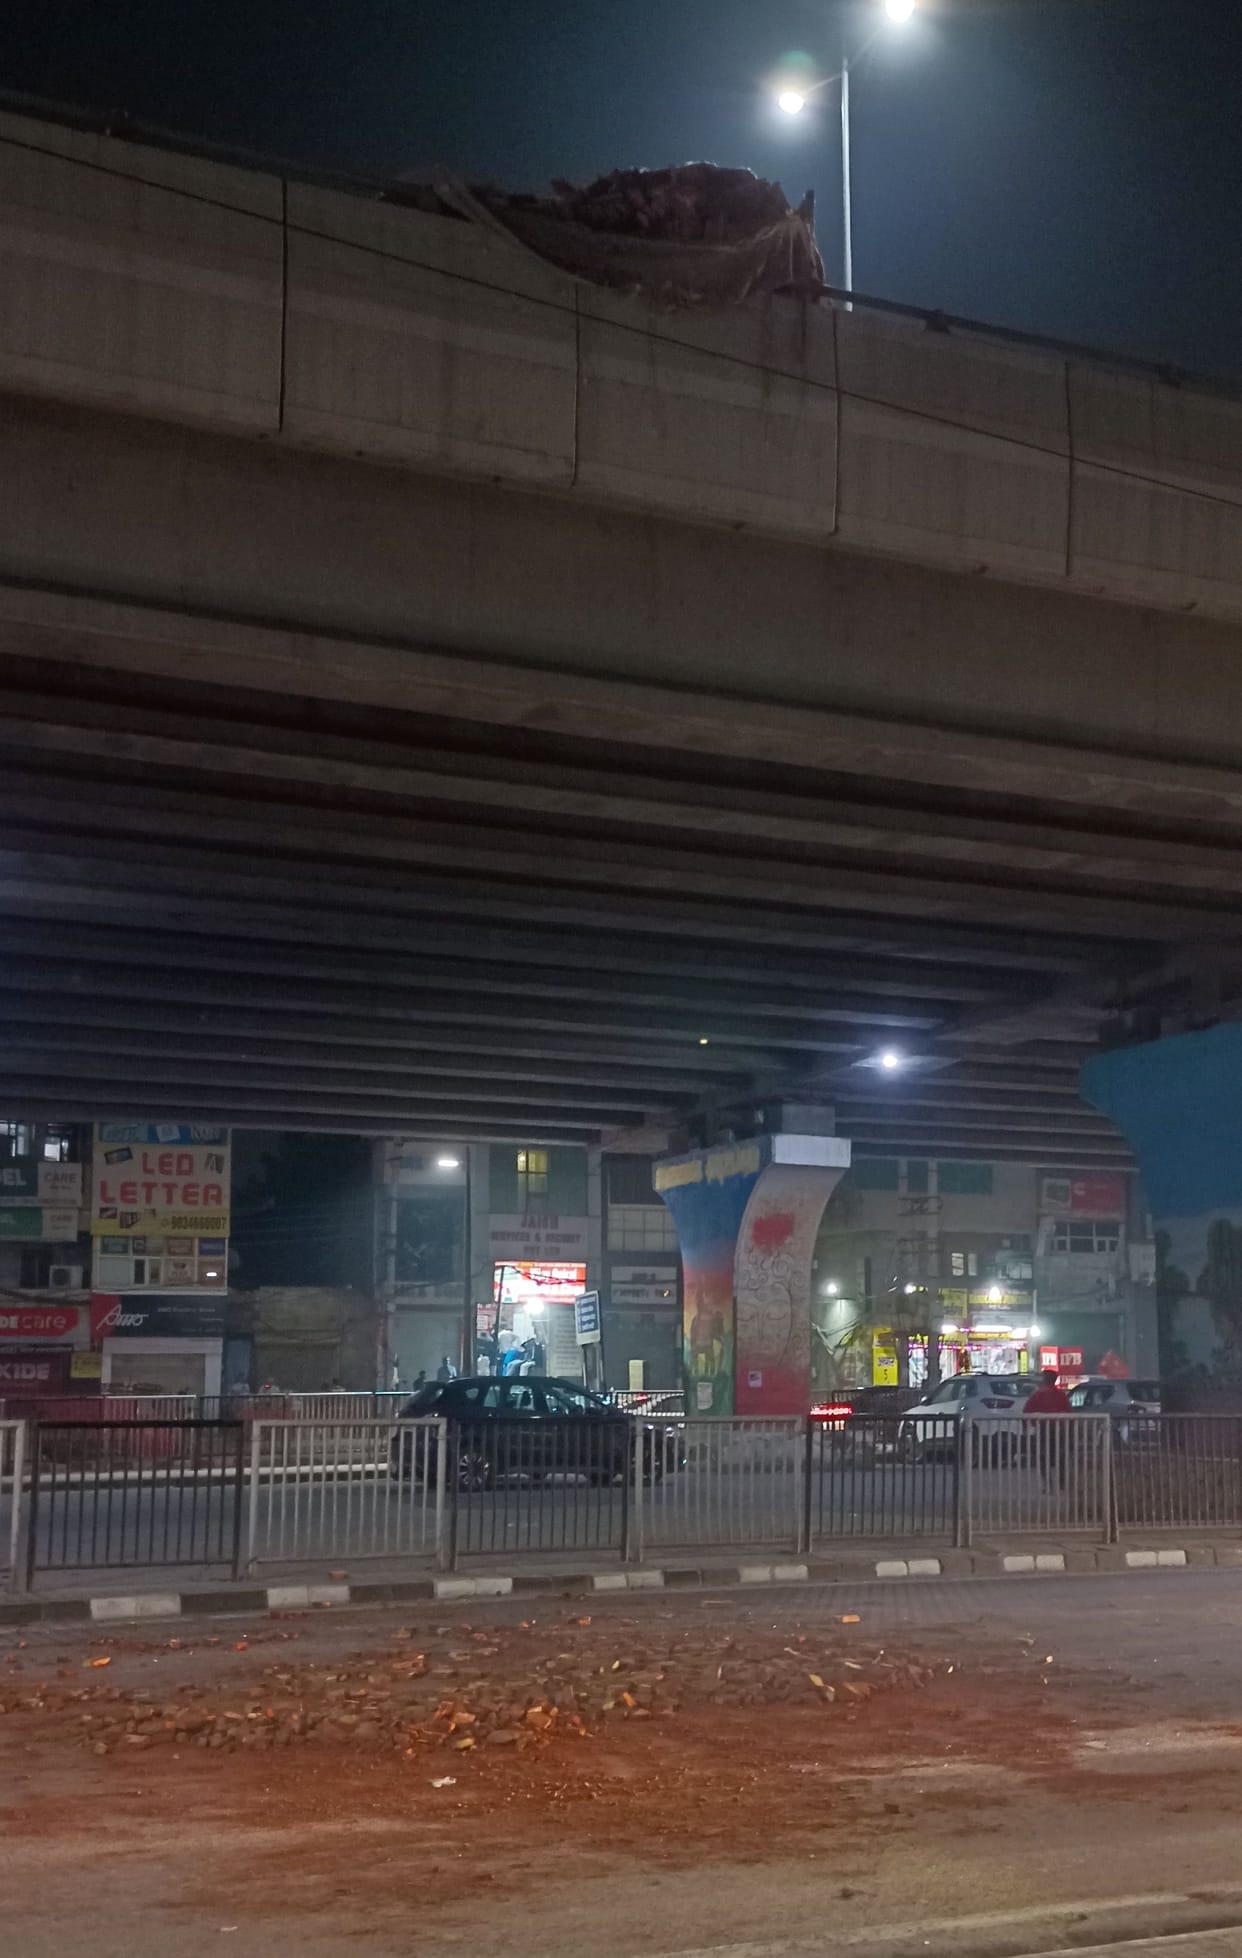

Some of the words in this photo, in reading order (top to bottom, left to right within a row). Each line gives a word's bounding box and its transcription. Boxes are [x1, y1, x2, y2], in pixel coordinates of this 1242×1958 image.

[142, 1151, 194, 1176] LED
[0, 1168, 27, 1187] EL
[44, 1172, 77, 1184] CARE
[99, 1179, 223, 1206] LETTER
[21, 1315, 67, 1329] care
